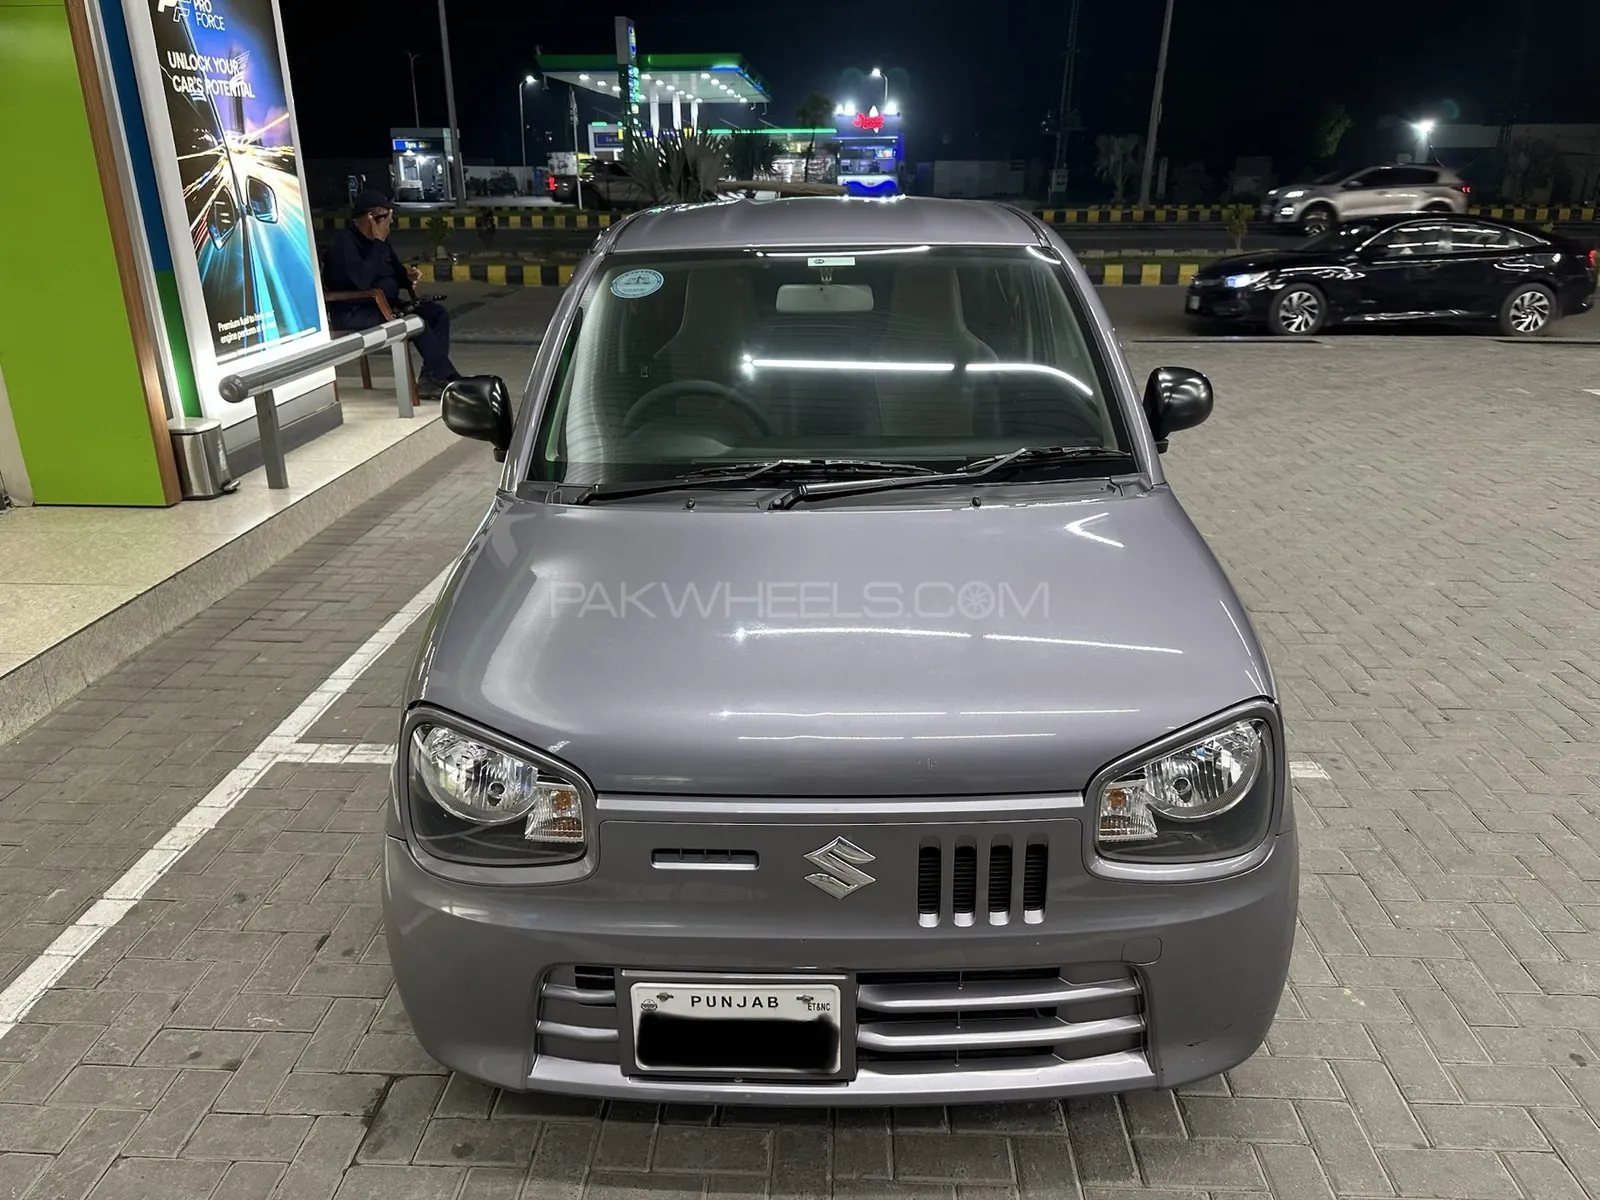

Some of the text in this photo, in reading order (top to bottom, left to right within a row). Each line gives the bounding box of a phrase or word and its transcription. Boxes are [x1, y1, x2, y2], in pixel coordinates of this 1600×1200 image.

[193, 0, 213, 13] PRO
[196, 12, 225, 31] FORCE
[167, 50, 240, 76] UNLOCK YOUR
[172, 75, 256, 99] CAR'S POTENTIAL
[218, 319, 240, 331] Premium
[240, 315, 249, 325] fuel
[249, 315, 255, 323] to
[221, 332, 238, 343] engine
[237, 327, 256, 340] perform
[690, 995, 780, 1009] PUNJAB
[807, 1002, 831, 1012] ET&NC
